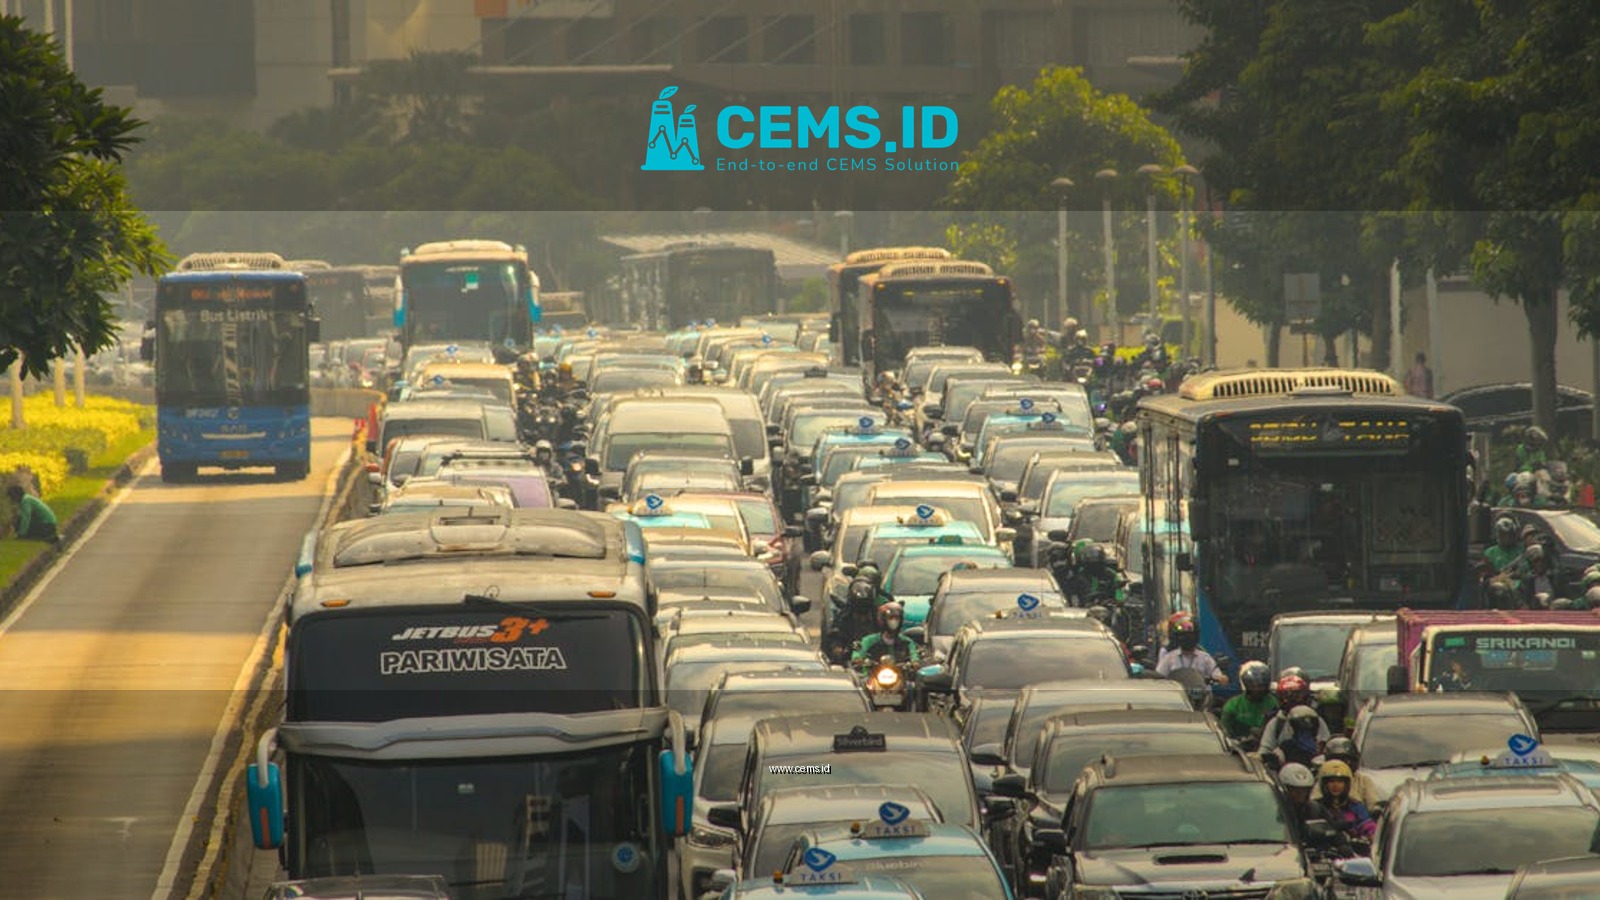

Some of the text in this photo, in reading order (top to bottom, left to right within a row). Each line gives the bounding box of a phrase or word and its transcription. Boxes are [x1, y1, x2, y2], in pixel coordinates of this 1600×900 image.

[201, 309, 224, 322] Bus
[380, 647, 567, 675] PARIWISATA
[1504, 757, 1545, 765] TAKSI
[875, 825, 916, 835] TAKSI
[801, 871, 842, 881] TAKSI
